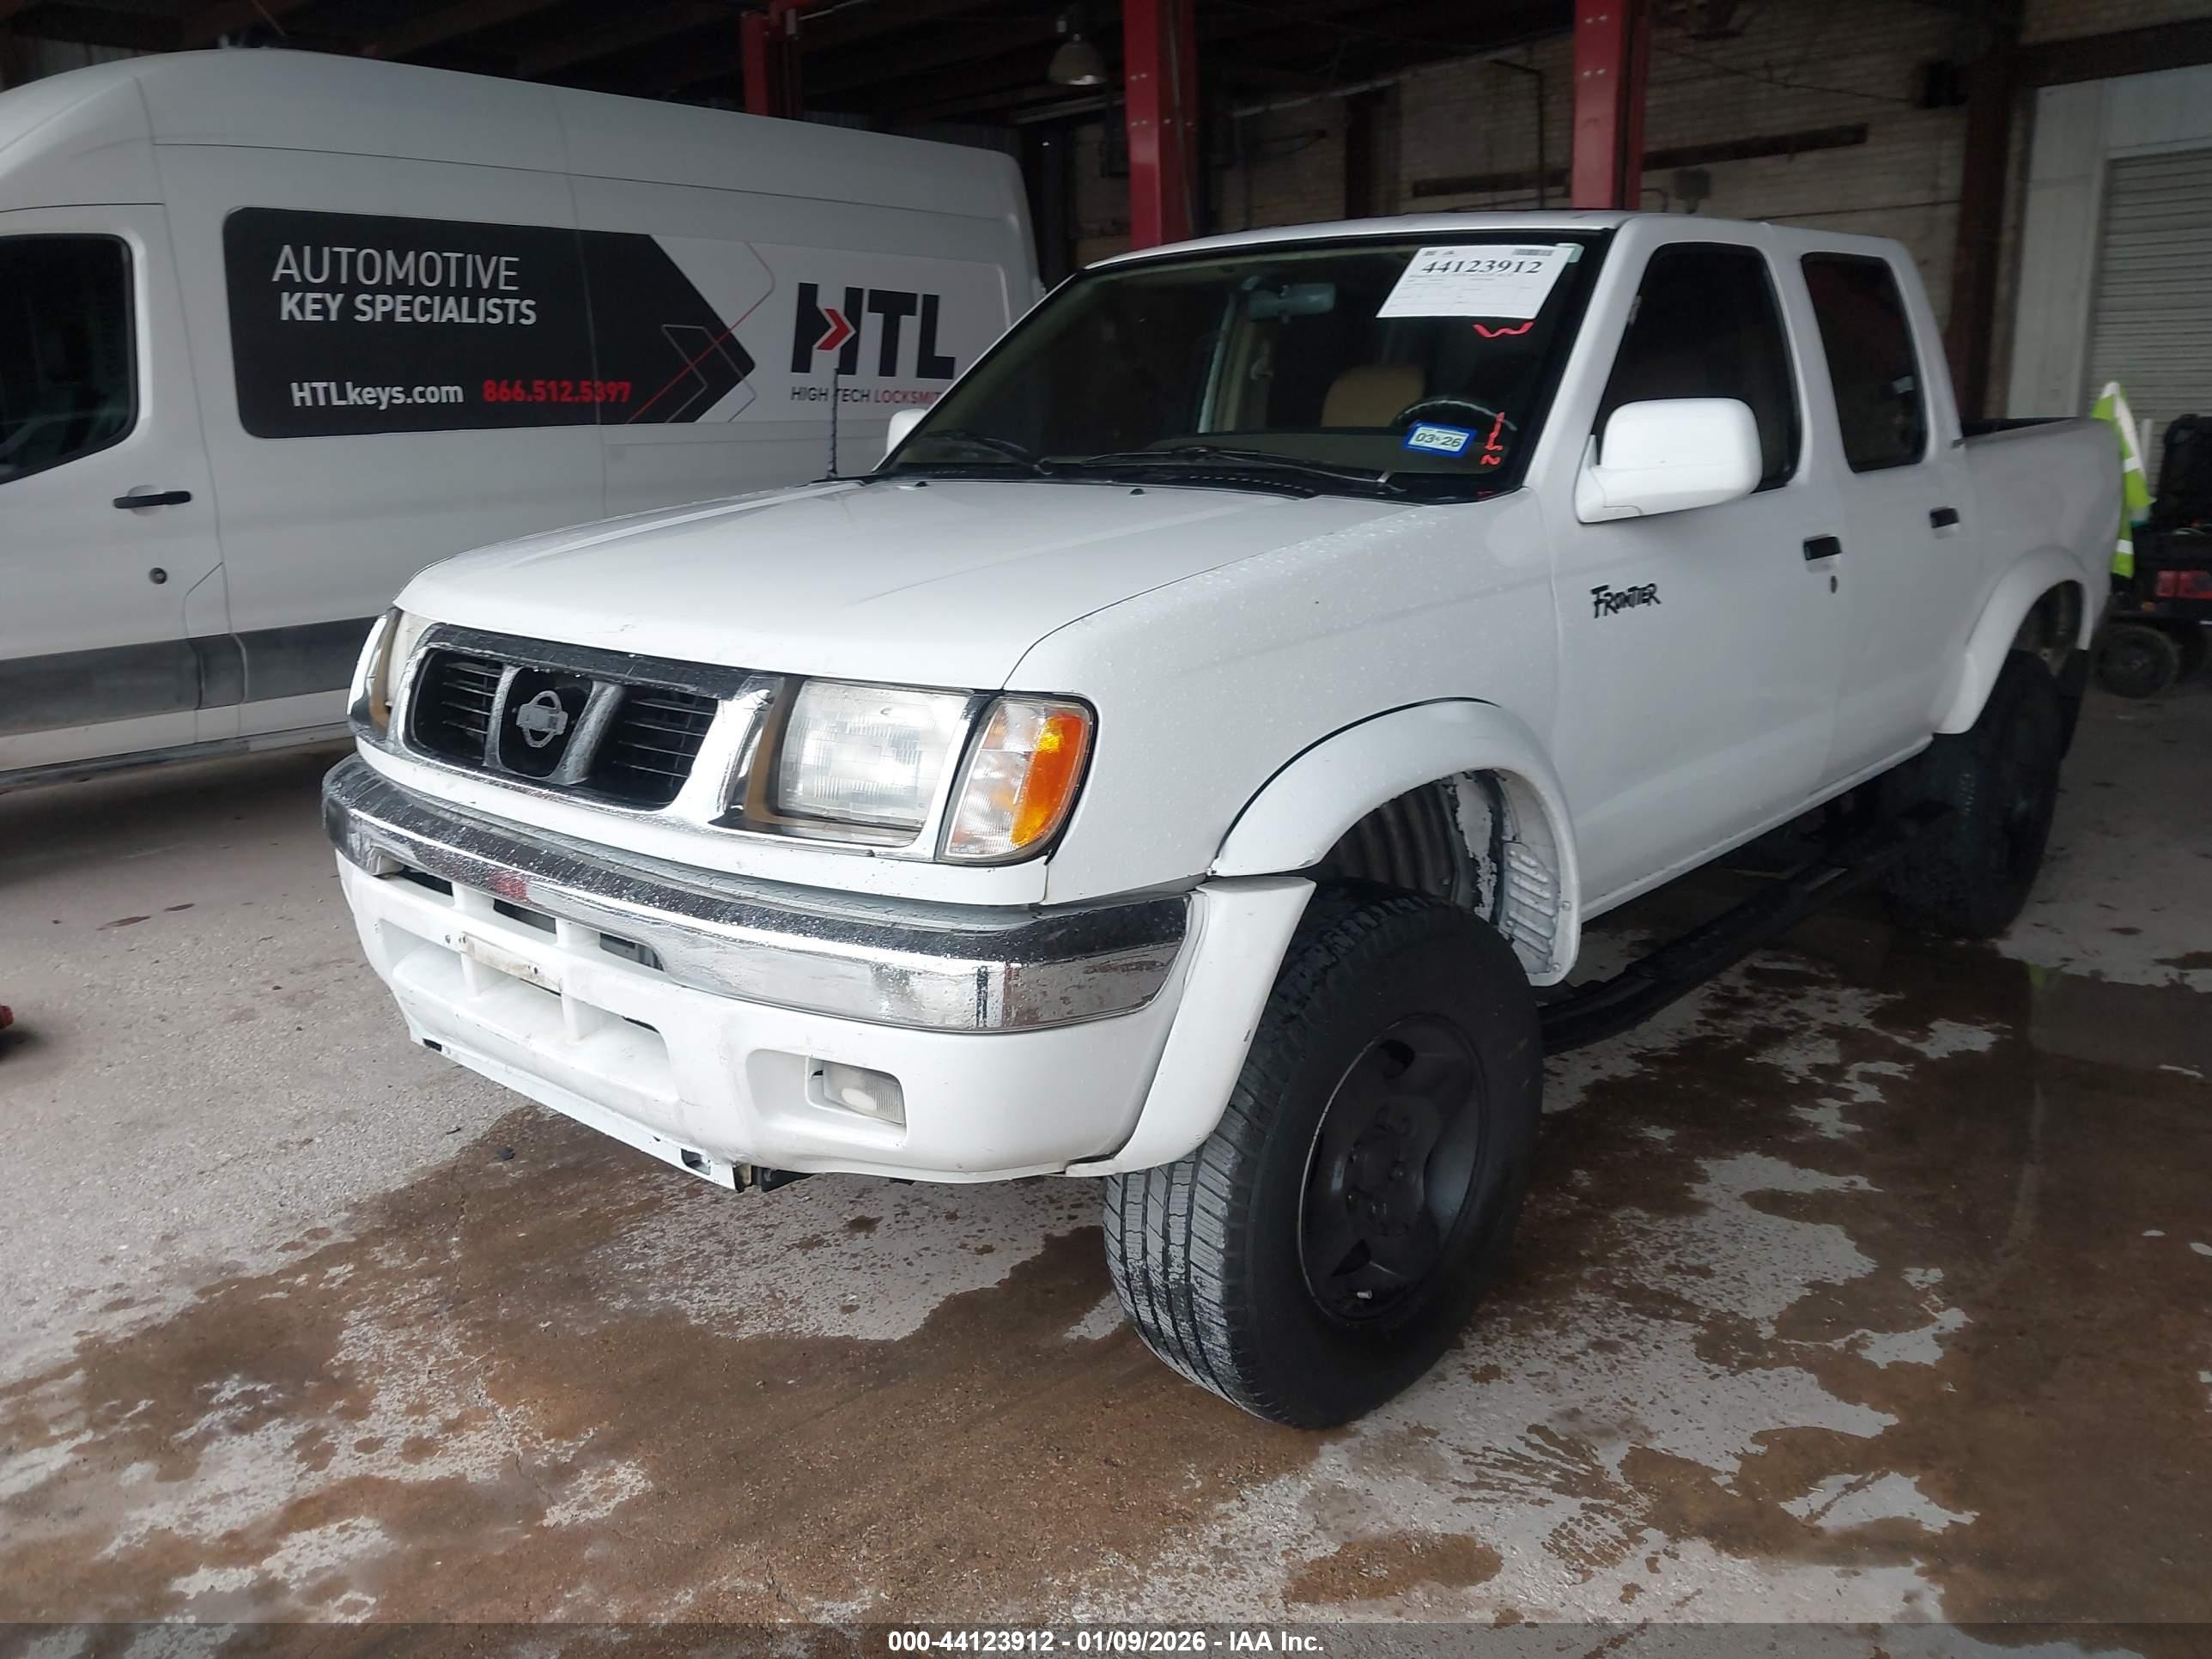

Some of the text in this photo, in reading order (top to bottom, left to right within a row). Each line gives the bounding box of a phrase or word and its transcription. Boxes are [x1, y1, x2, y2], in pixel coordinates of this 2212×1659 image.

[272, 245, 520, 290] AUTOMOTIVE
[1422, 259, 1543, 274] 44123912
[281, 292, 537, 326] KEY SPECIALISTS
[791, 282, 956, 380] HTL
[290, 380, 632, 410] HTLkeys.com 866.512.5397
[791, 387, 943, 404] HIGH TECH LOCKSMIT
